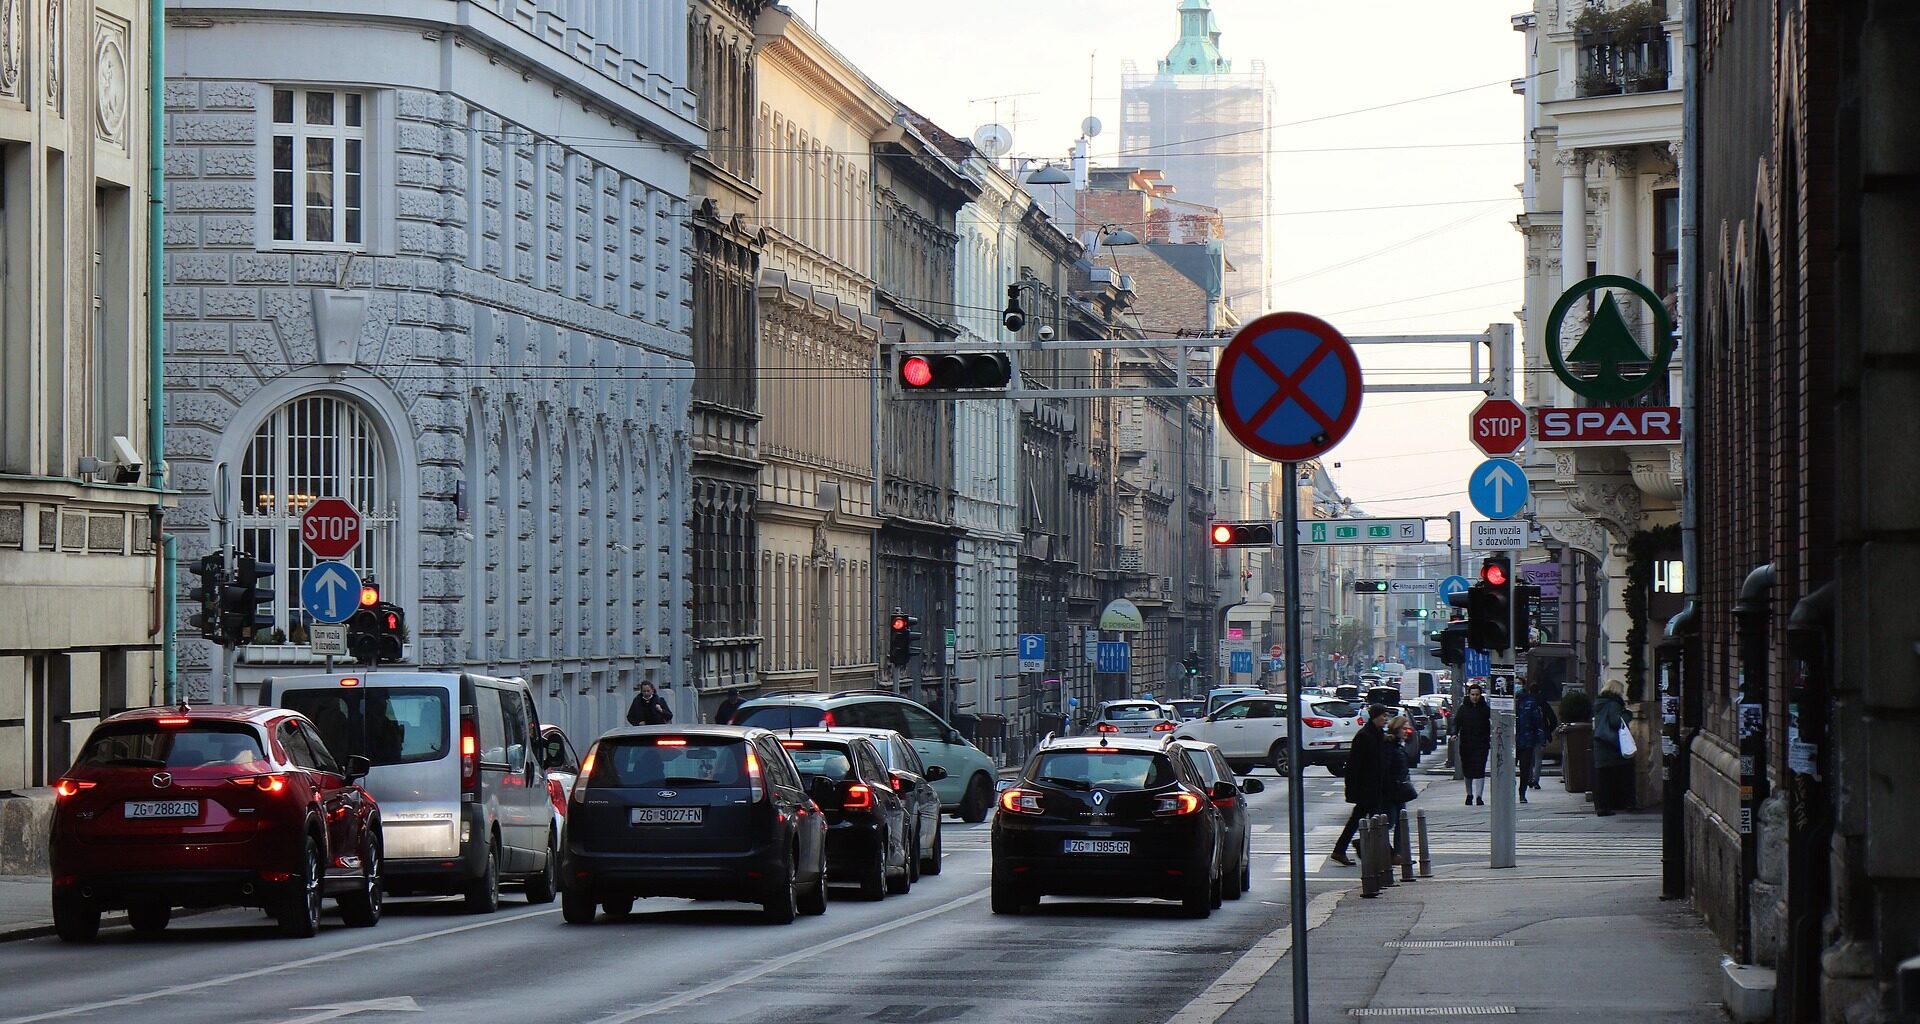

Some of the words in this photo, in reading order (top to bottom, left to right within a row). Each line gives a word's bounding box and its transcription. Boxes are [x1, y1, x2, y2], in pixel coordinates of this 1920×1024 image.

[1479, 417, 1522, 437] STOP
[1544, 411, 1672, 437] SPAR
[305, 515, 357, 541] STOP
[1478, 525, 1497, 535] Osim
[1500, 525, 1521, 535] vozila
[1478, 538, 1483, 546] s
[1485, 536, 1521, 546] dozvolom
[1026, 639, 1038, 655] P
[133, 803, 147, 816] ZG
[154, 803, 198, 816] 2882-DS
[639, 810, 653, 821] ZG
[659, 809, 701, 821] 9027-FN
[1071, 841, 1085, 852] ZG
[1091, 841, 1129, 853] 1985-GR
